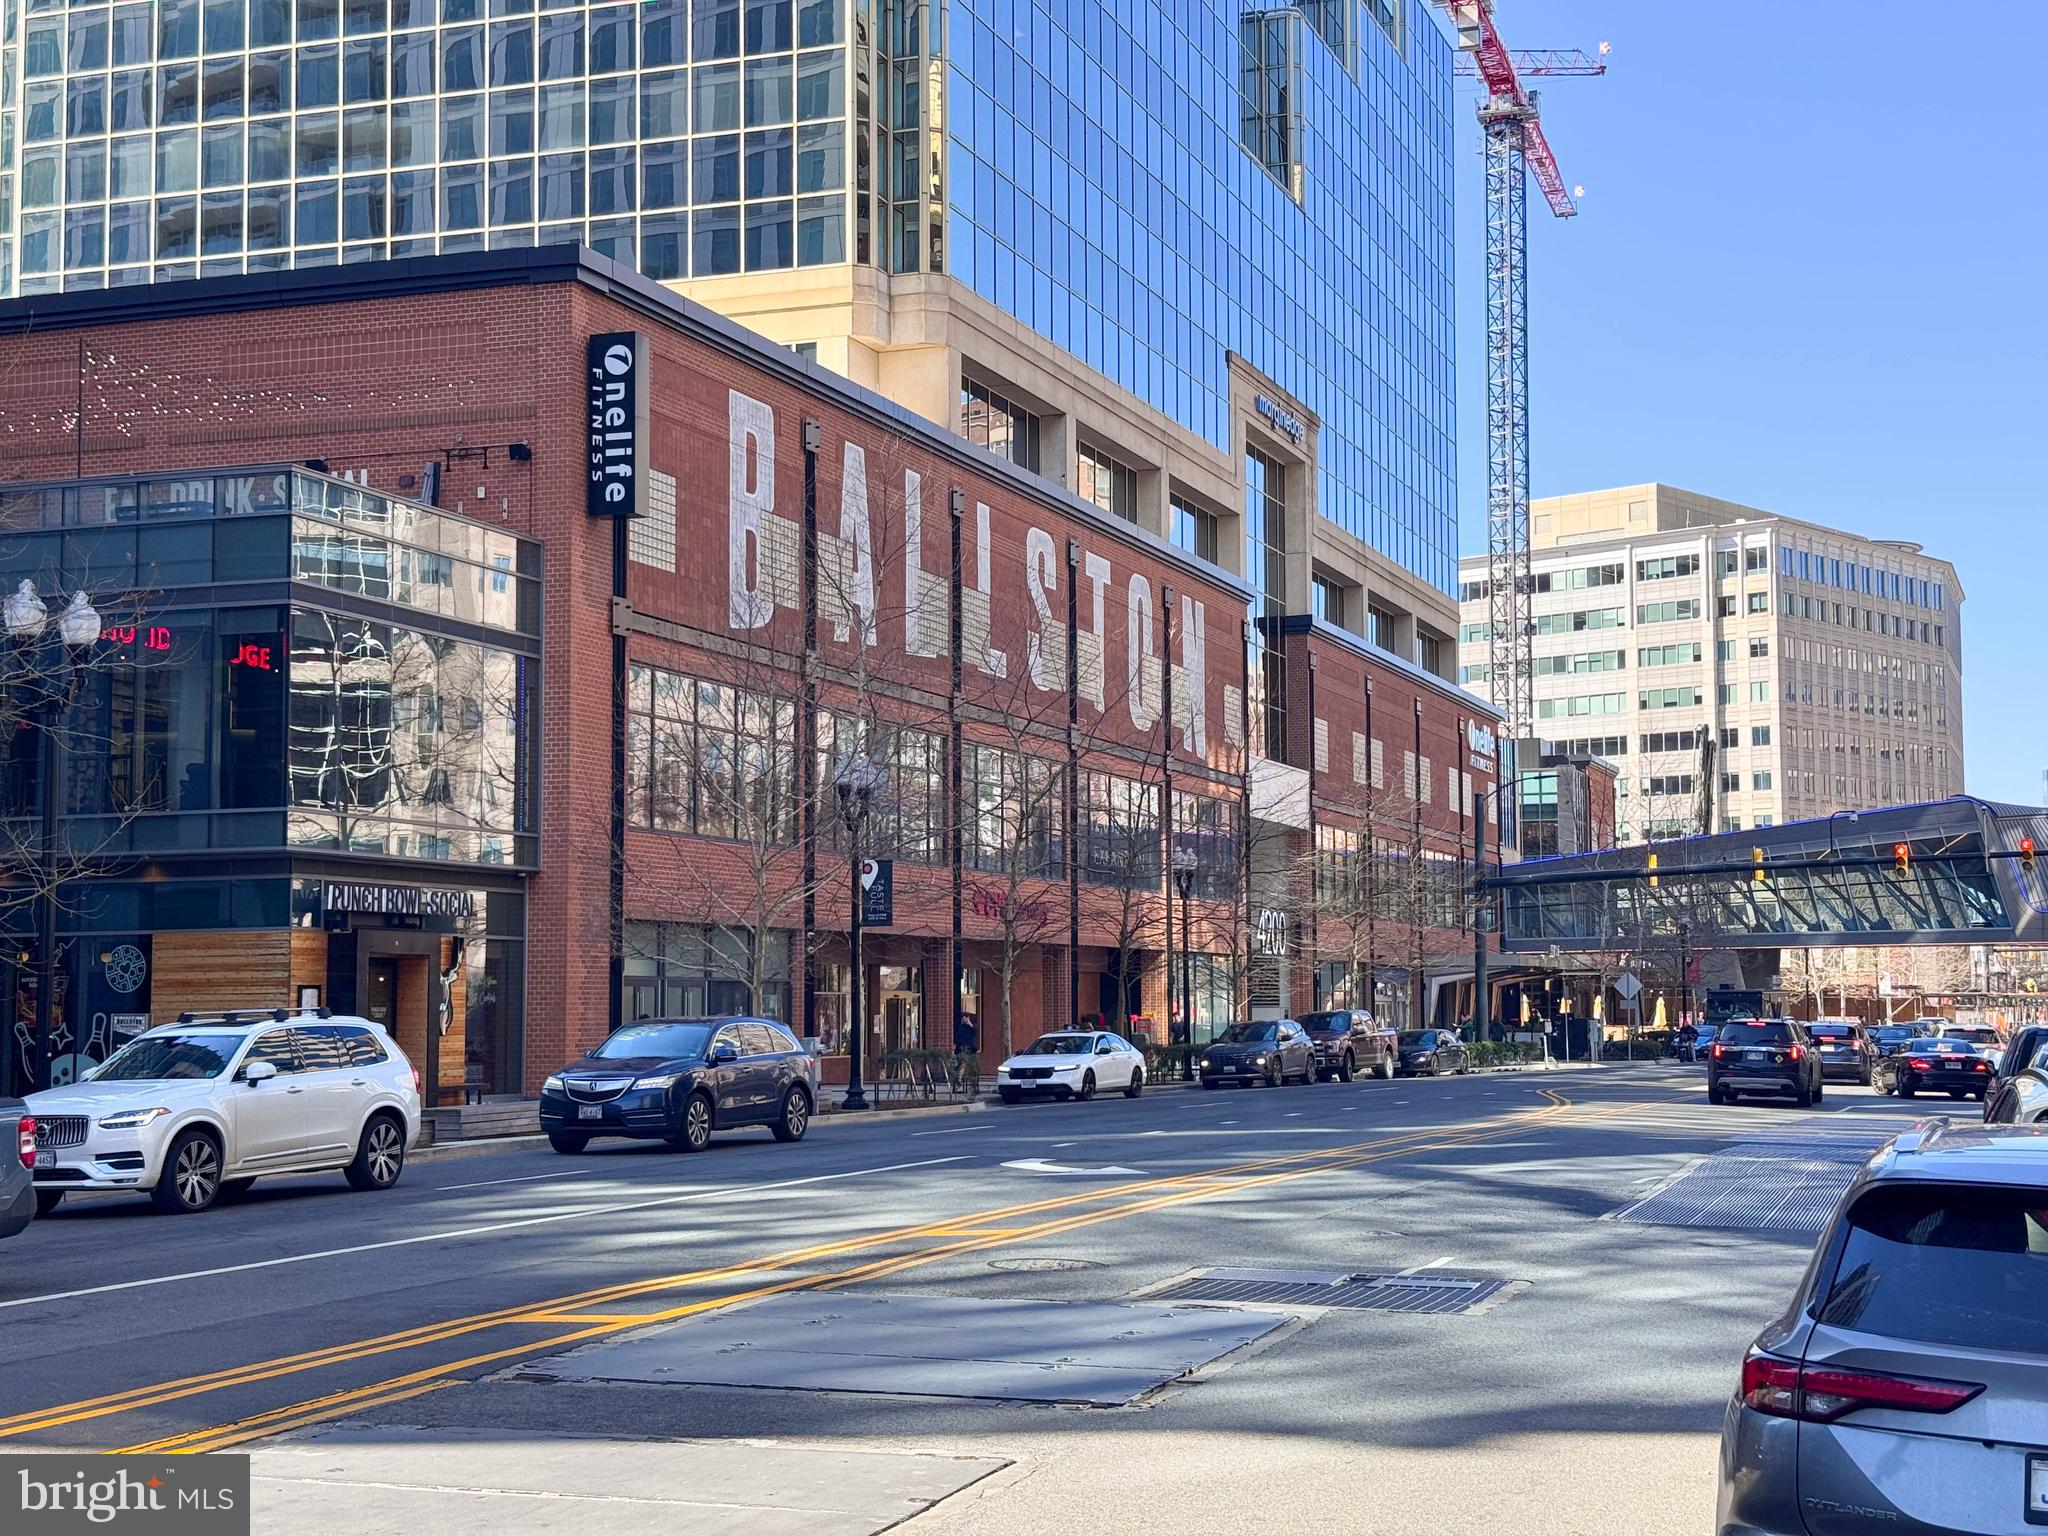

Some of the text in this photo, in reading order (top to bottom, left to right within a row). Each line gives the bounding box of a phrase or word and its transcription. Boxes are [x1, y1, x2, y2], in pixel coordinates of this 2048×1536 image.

[592, 367, 603, 482] FITNESS
[729, 388, 1206, 760] BALLSTON
[328, 884, 476, 918] PUNCH BOWL SOCIAL
[1256, 908, 1287, 956] 4200
[1805, 1497, 1898, 1521] OUTLANDER
